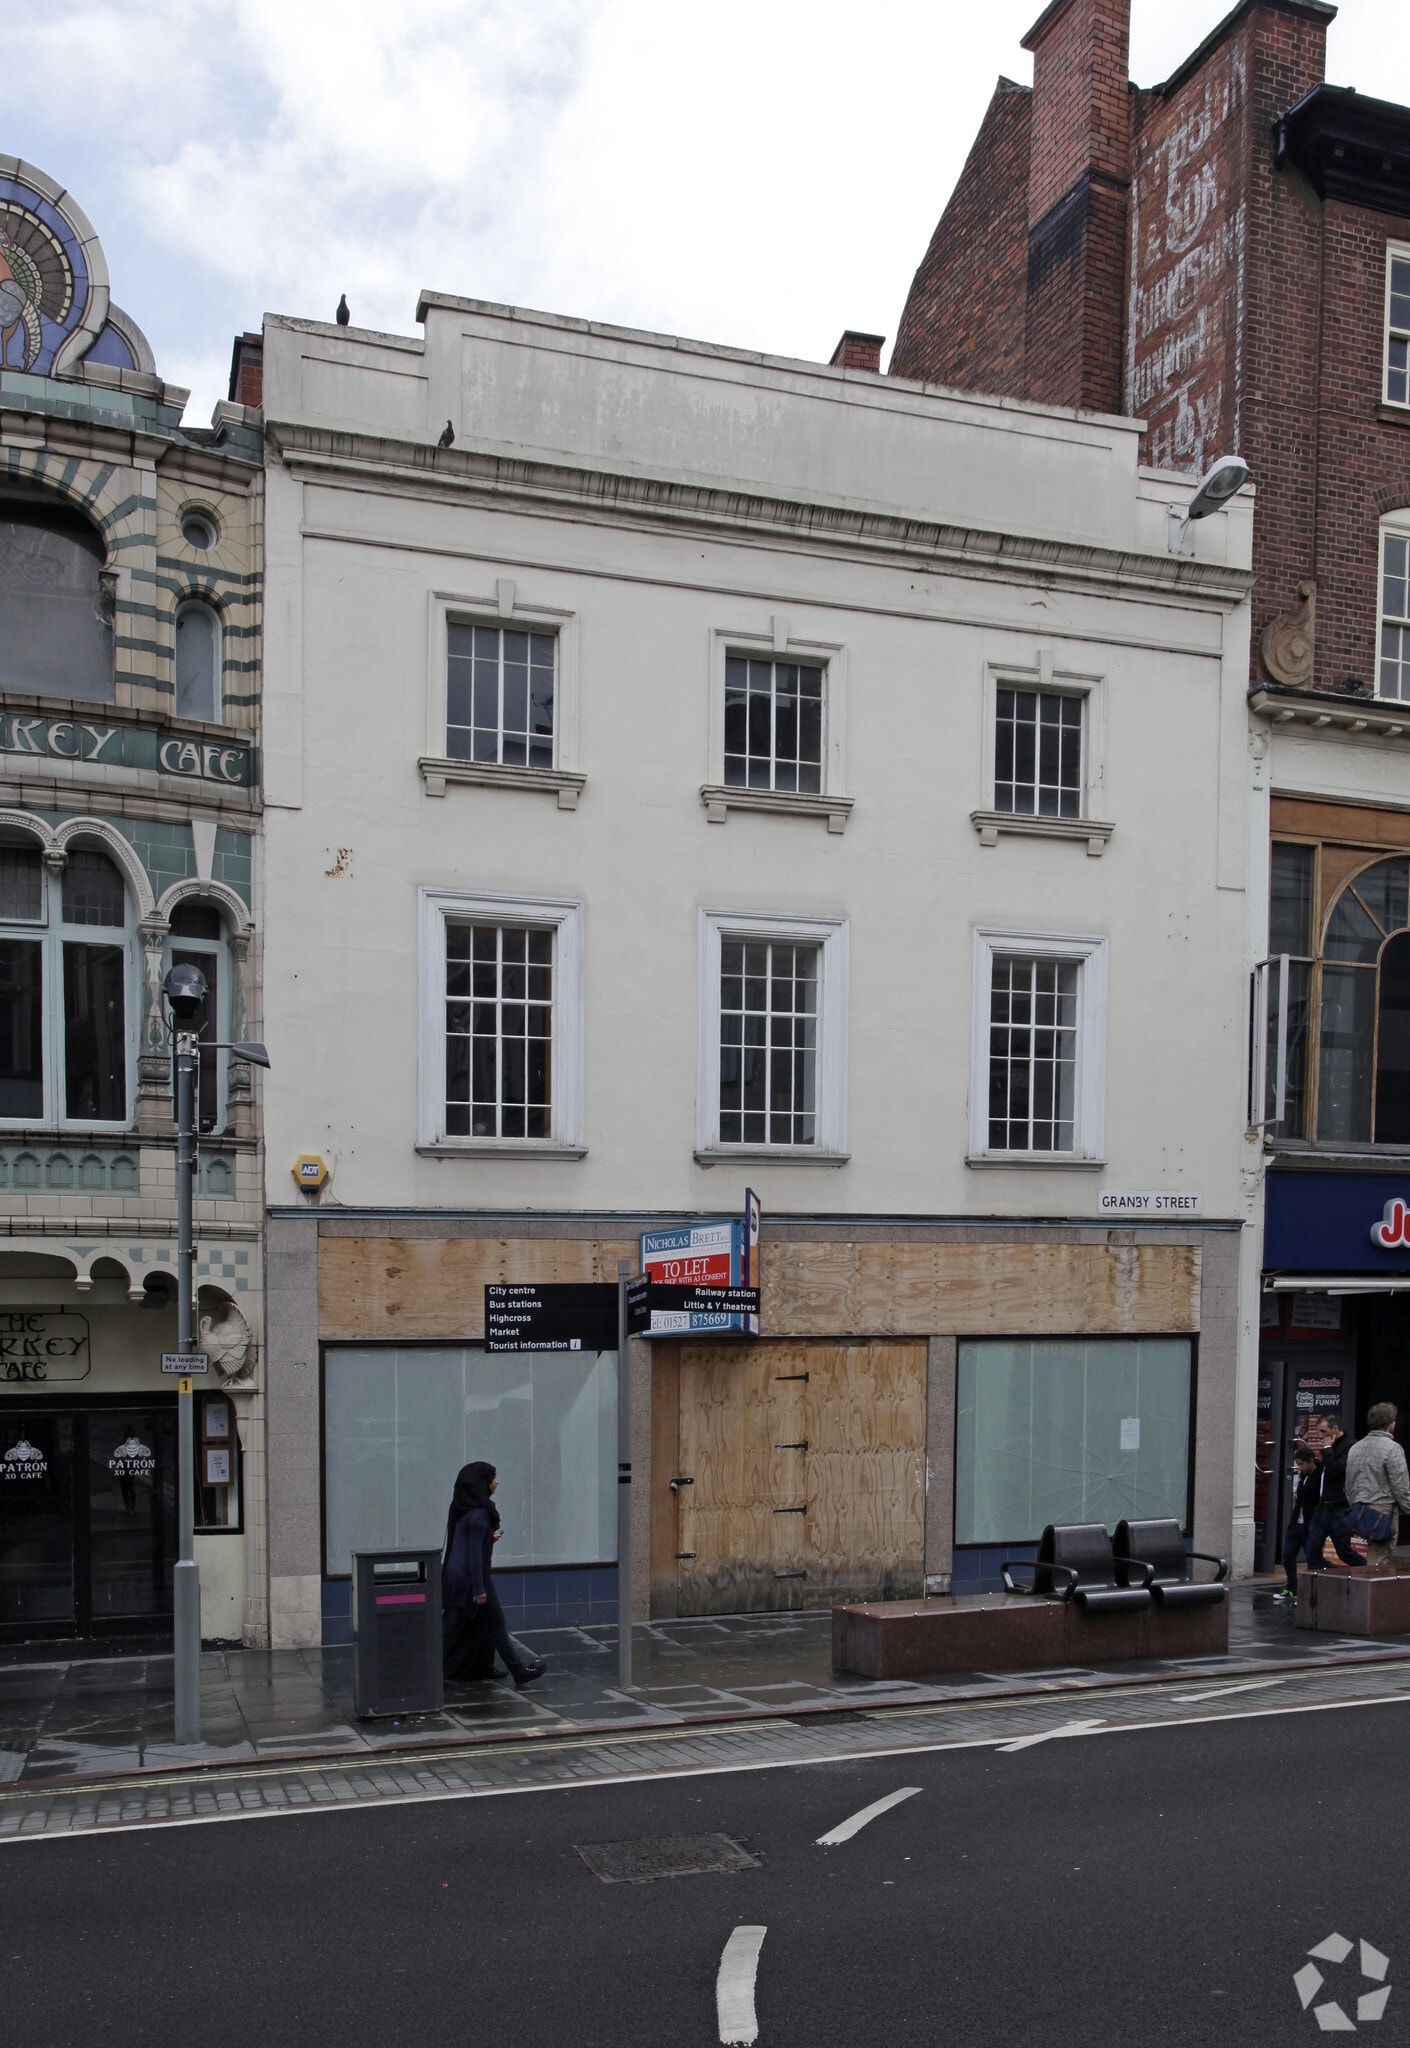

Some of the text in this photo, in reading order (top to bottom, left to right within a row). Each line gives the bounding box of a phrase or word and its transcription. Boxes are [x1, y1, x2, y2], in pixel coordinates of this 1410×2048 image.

[301, 1165, 319, 1175] ADT
[1155, 1196, 1198, 1209] STREET
[646, 1231, 721, 1251] NICHOLAS BRETT
[662, 1258, 710, 1279] TO LET
[678, 1276, 692, 1284] WITH
[694, 1274, 701, 1282] A3
[701, 1272, 727, 1281] CONSENT
[489, 1286, 536, 1296] City centre
[695, 1287, 757, 1298] Railway station
[489, 1300, 543, 1309] Bus stations
[684, 1300, 757, 1311] Little & Y theatres
[489, 1314, 532, 1324] Highcross
[663, 1315, 688, 1329] 01527
[692, 1312, 727, 1327] 875669
[489, 1328, 520, 1336] Market
[489, 1341, 518, 1350] Tourist
[520, 1340, 568, 1349] information
[178, 1356, 204, 1364] loading
[182, 1380, 188, 1391] 1
